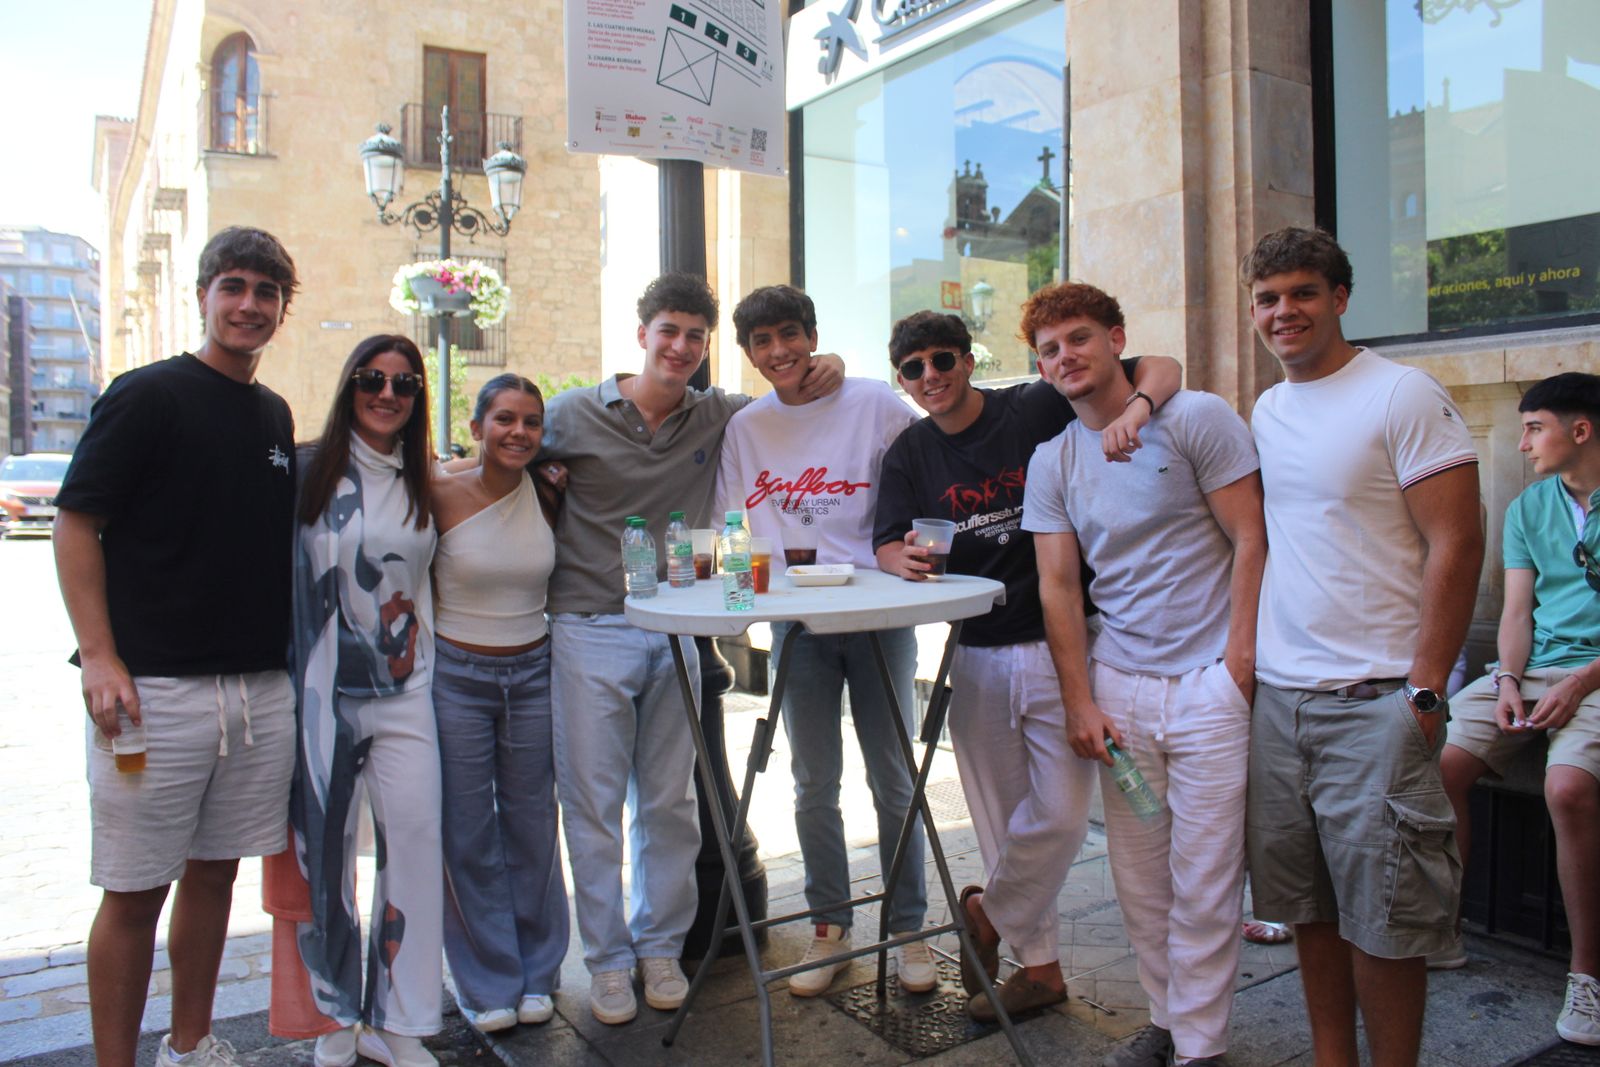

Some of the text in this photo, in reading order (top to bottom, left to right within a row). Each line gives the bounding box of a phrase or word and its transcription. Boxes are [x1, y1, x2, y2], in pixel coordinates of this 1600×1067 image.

[681, 12, 686, 22] 1
[604, 23, 625, 31] CUATRO
[713, 29, 720, 40] 2
[744, 47, 750, 58] 3
[1528, 273, 1535, 286] y
[1539, 266, 1581, 282] ahora
[811, 498, 841, 507] URBAN
[782, 506, 829, 515] AESTHETICS
